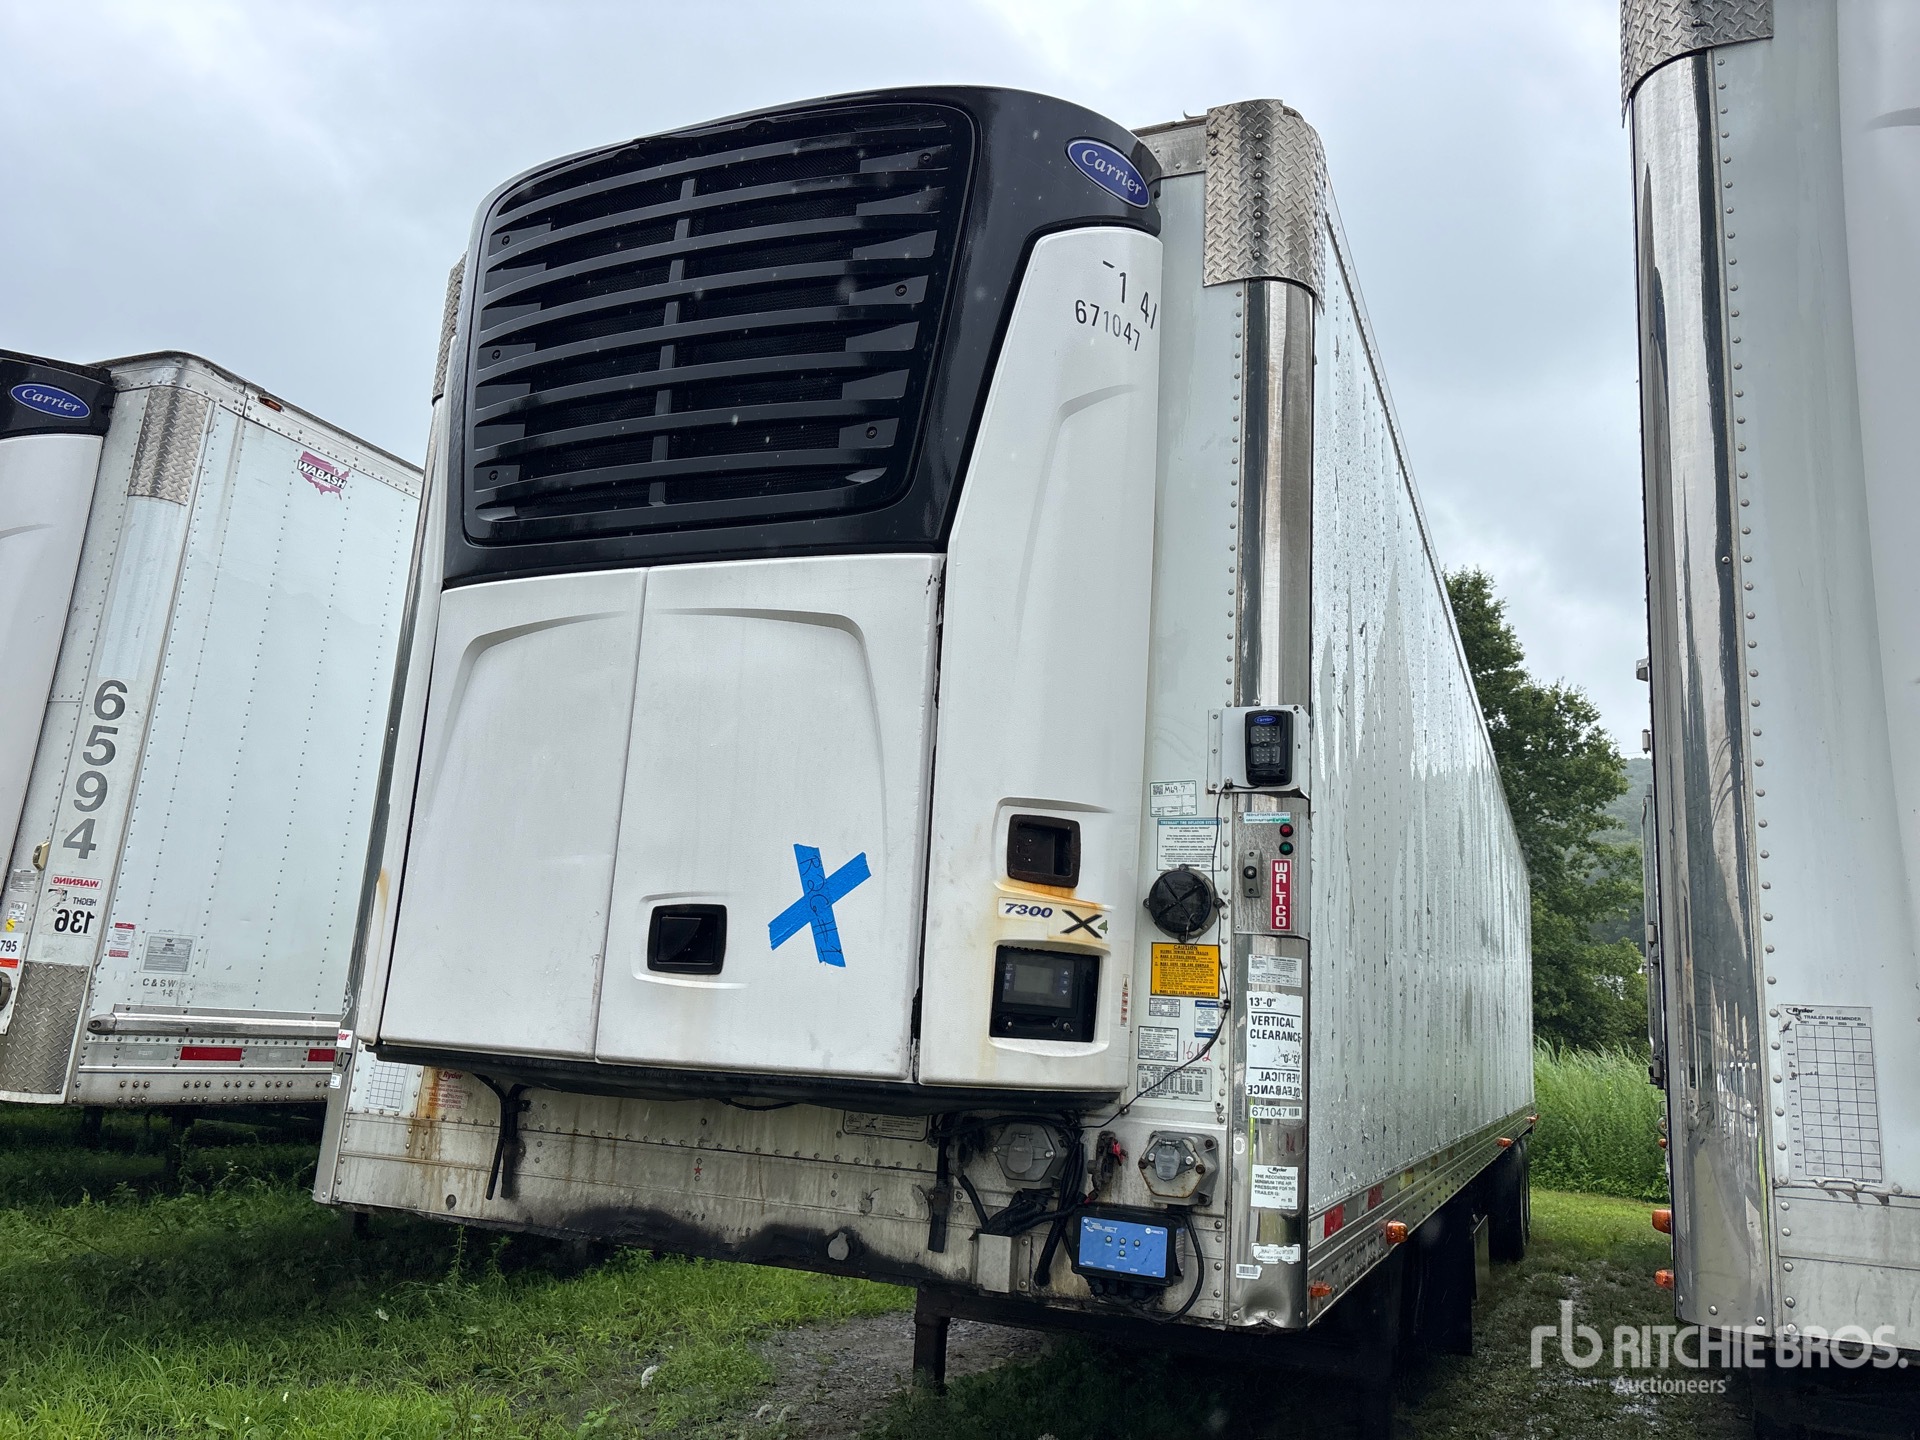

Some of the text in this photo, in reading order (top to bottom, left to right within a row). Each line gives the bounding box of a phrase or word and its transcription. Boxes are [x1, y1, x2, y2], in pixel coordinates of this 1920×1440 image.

[1081, 148, 1143, 196] Carrier
[1075, 299, 1141, 351] 671047
[21, 388, 81, 412] Carrier
[298, 460, 347, 489] WABASH
[62, 679, 128, 860] 6594
[1274, 862, 1287, 928] WALTCO
[1004, 902, 1053, 919] 7300
[1251, 1015, 1295, 1028] VERTICAL
[1250, 1028, 1302, 1042] CLEARANCE
[442, 1070, 463, 1080] Ryder
[1252, 1106, 1287, 1117] 671047
